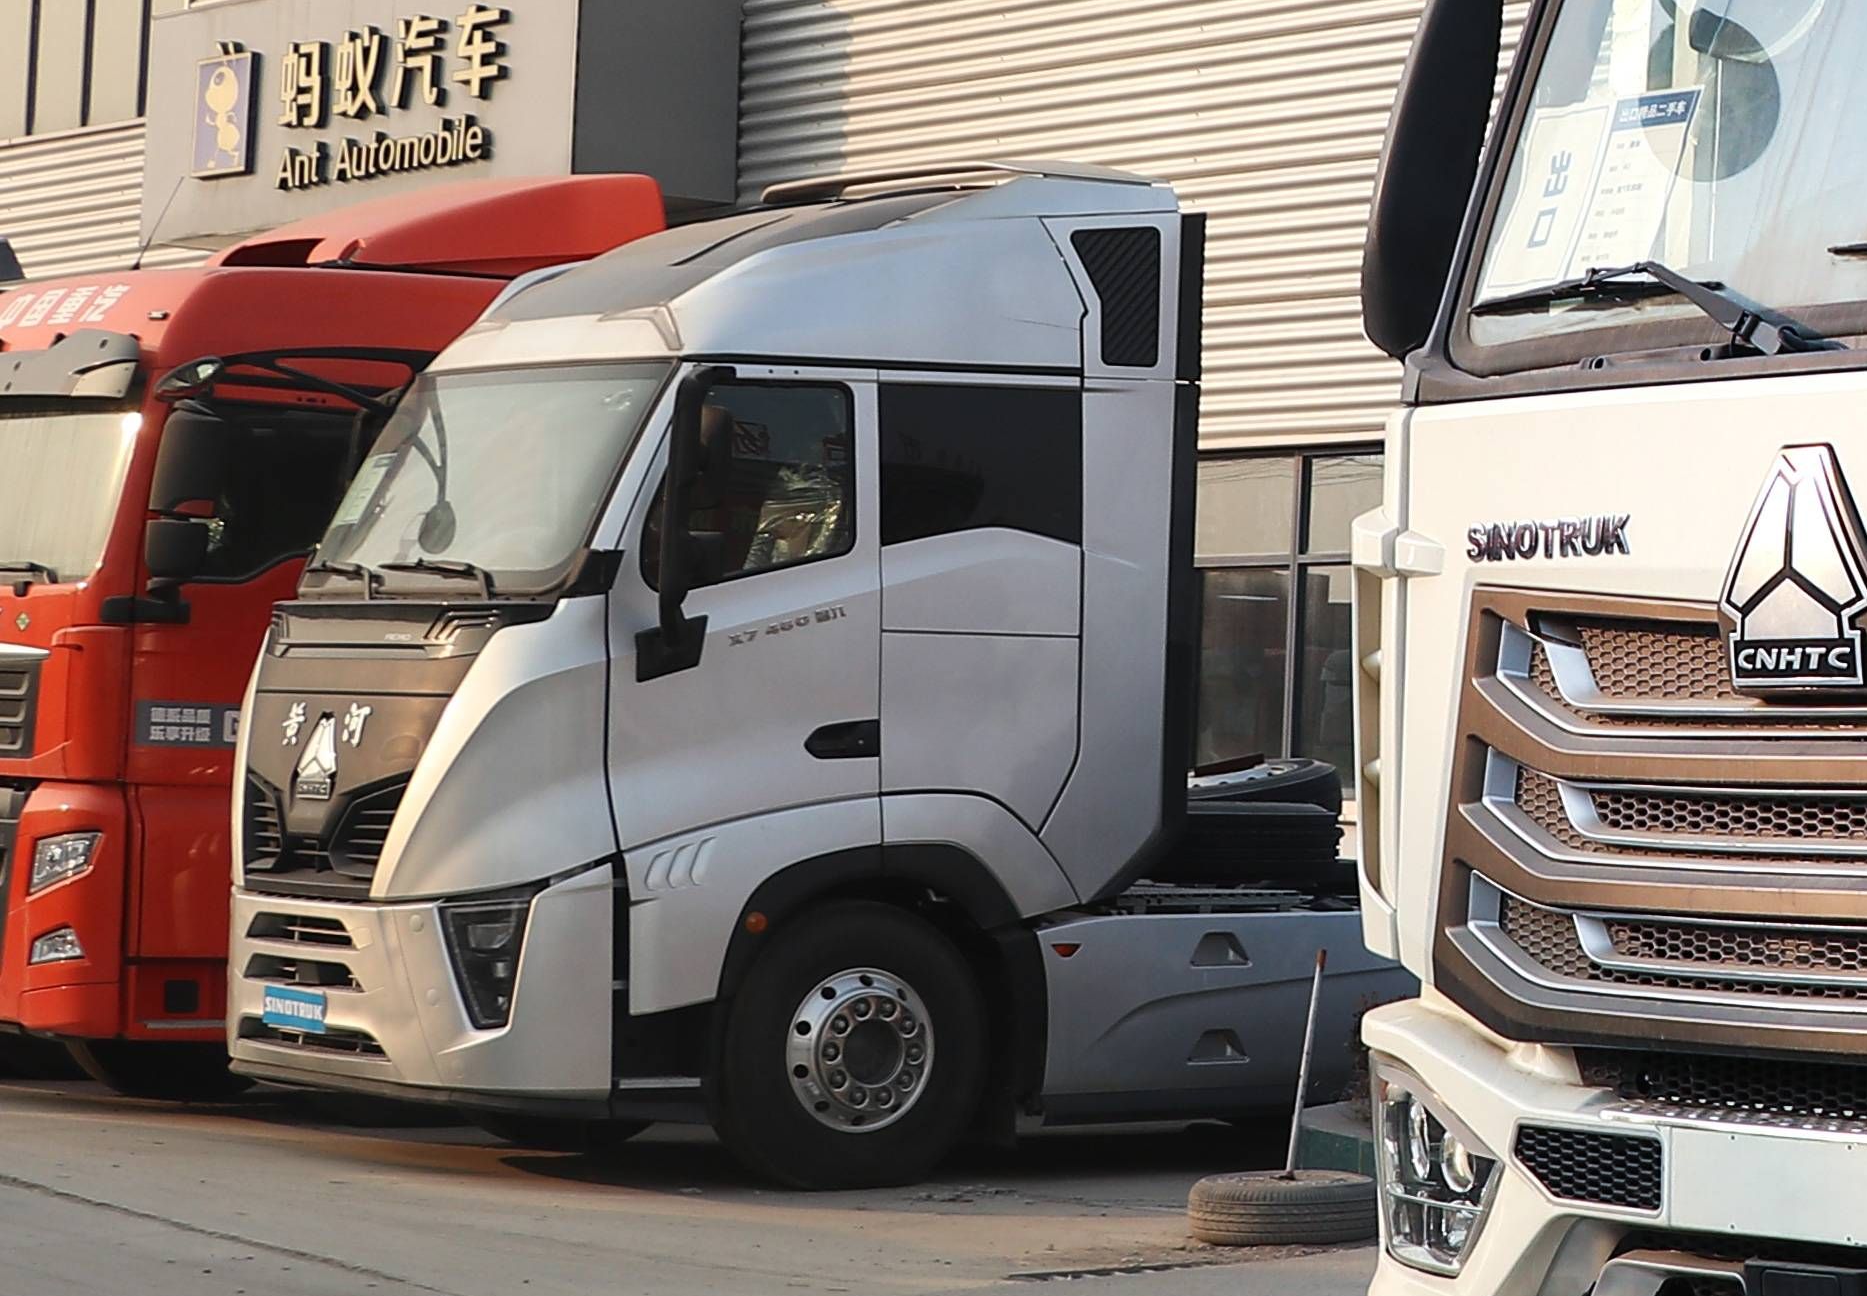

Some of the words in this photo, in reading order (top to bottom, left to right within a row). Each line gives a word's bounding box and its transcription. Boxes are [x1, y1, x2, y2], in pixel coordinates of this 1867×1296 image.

[279, 4, 506, 128] 蚂蚁汽车
[276, 146, 323, 189] Ant
[335, 114, 487, 180] Automobile
[1466, 512, 1632, 564] SINOTRUK
[1737, 646, 1851, 671] CNHTC
